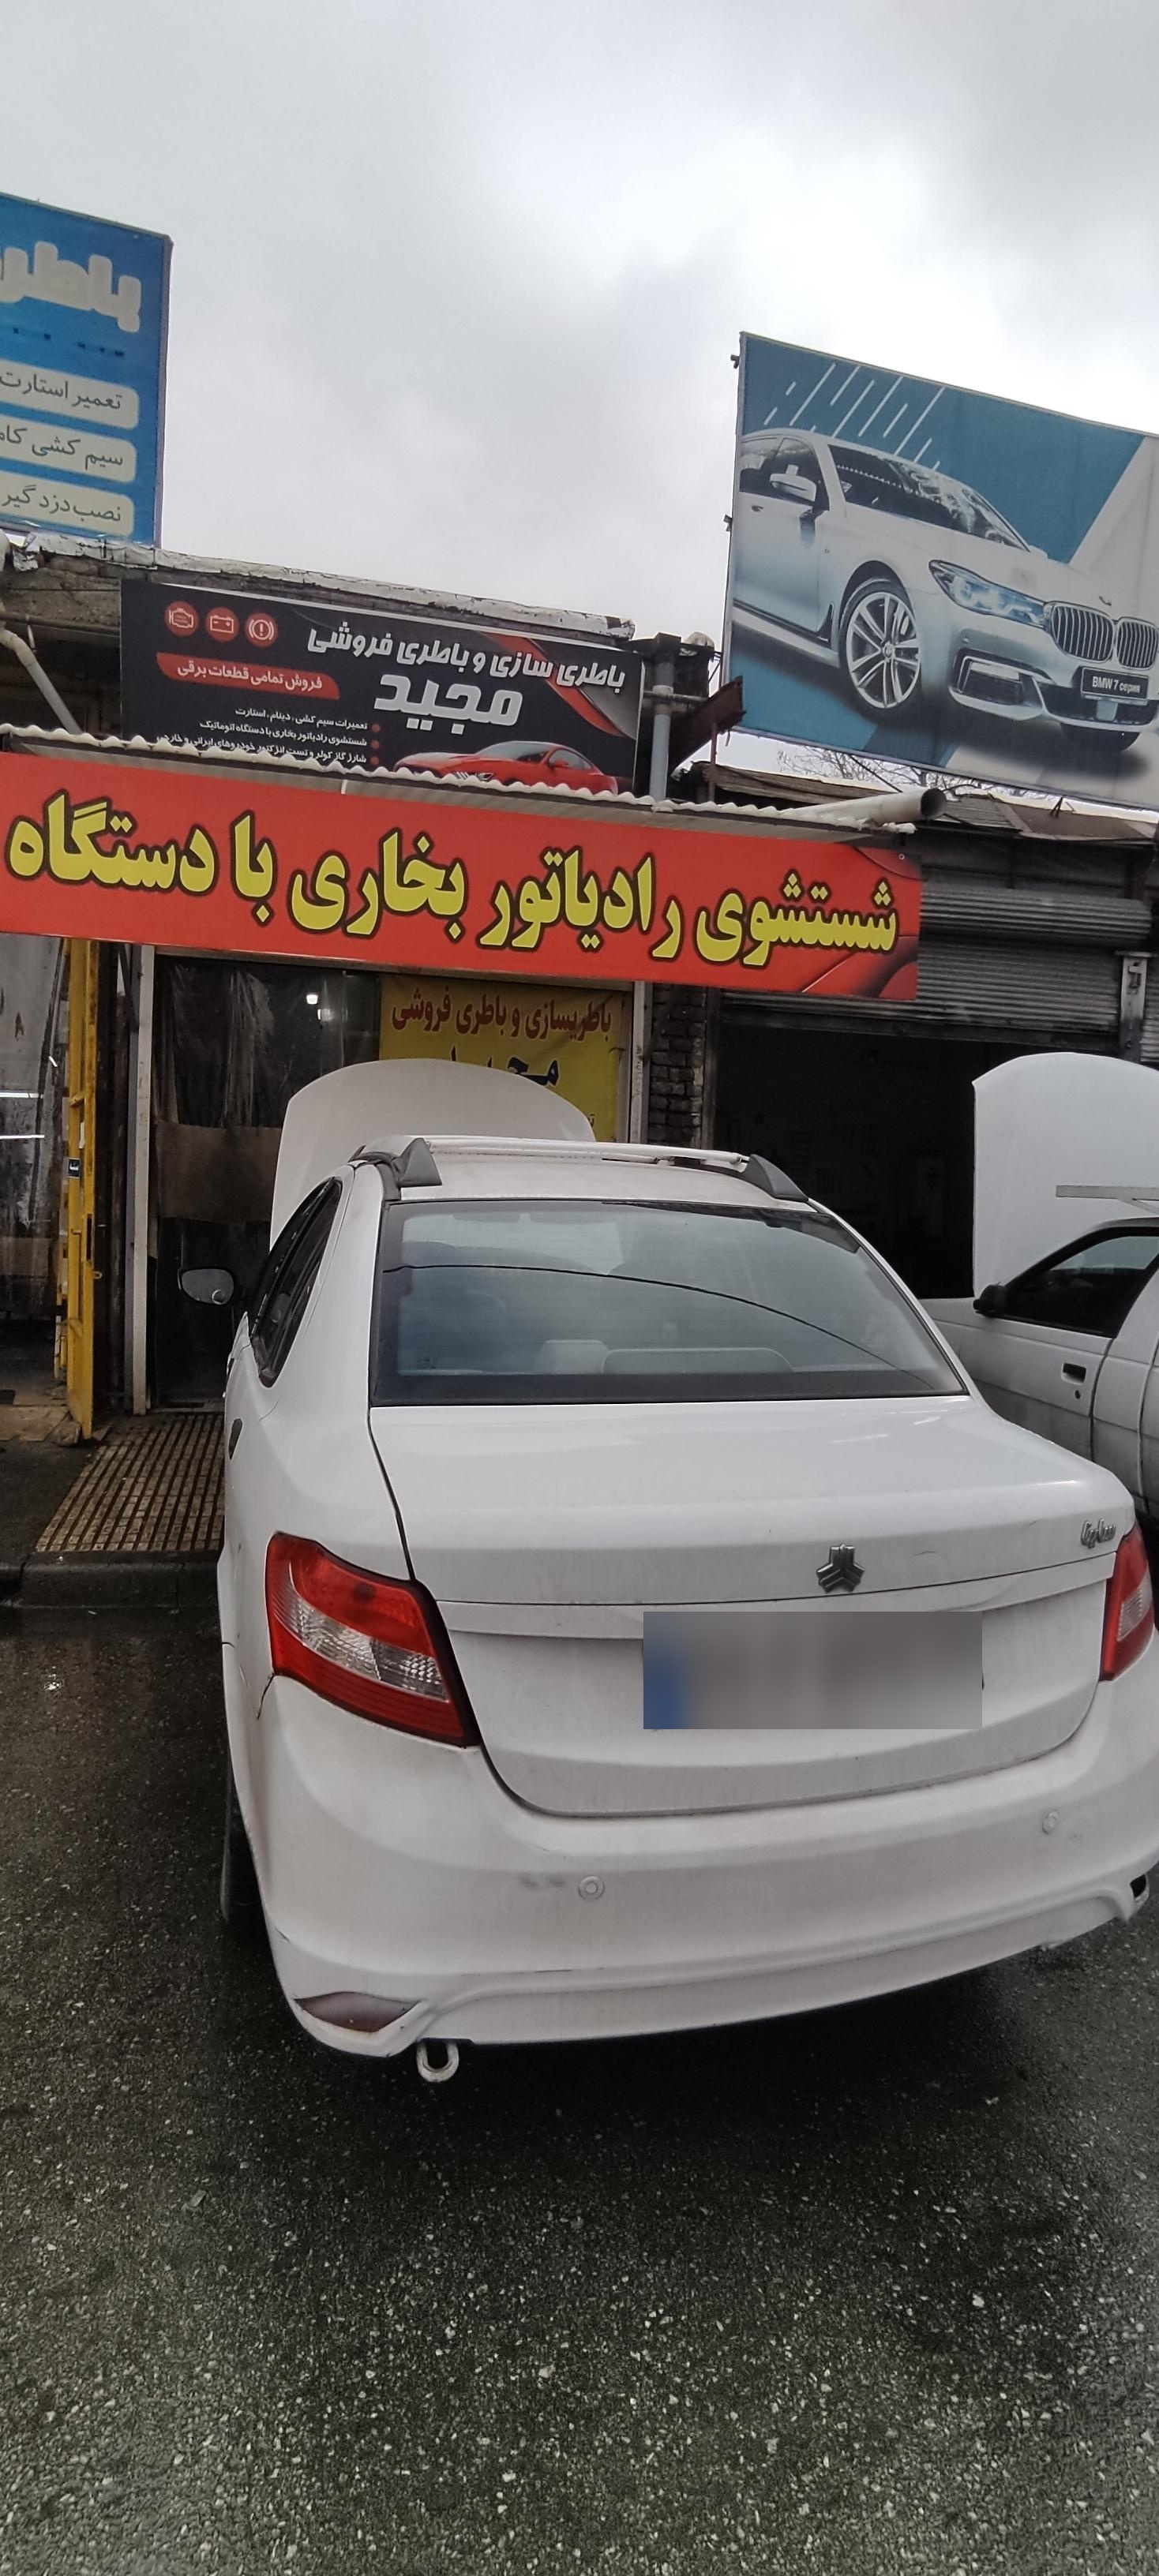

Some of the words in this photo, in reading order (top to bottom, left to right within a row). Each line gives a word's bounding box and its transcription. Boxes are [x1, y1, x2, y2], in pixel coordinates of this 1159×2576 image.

[0, 241, 142, 333] باطر
[0, 372, 68, 399] استارت
[72, 394, 122, 409] تعمیر
[0, 425, 28, 444] کام
[32, 436, 81, 456] کشی
[85, 453, 123, 470] سیم
[73, 506, 121, 522] نصب
[307, 621, 393, 657] فروشی
[397, 638, 467, 672] باطری
[473, 653, 486, 672] و
[178, 660, 207, 678] برقی
[208, 665, 249, 680] قطعات
[489, 651, 553, 678] سازی
[251, 671, 283, 685] تمامی
[285, 674, 322, 691] فروش
[556, 661, 625, 693] باطری
[1092, 676, 1113, 691] BMW
[1113, 679, 1120, 691] 7
[373, 672, 523, 735] مجید
[235, 708, 266, 718] استارت
[200, 721, 235, 733] اتوماتیک
[236, 724, 265, 735] دستگاه
[317, 718, 334, 728] سیم
[335, 719, 368, 730] تعمیرات
[157, 734, 183, 743] خارج
[272, 728, 297, 740] بخاری
[297, 732, 328, 743] رادیاتور
[328, 736, 367, 747] شستشوی
[316, 750, 332, 762] کولر
[347, 752, 366, 763] شارژ
[9, 793, 216, 893] دستگاه
[233, 814, 276, 923] با
[289, 830, 465, 941] بخاری
[478, 848, 684, 960] رادیاتور
[695, 871, 898, 967] شستشوی
[392, 986, 452, 1032] فروشی
[456, 994, 507, 1035] باطری
[511, 1004, 520, 1037] و
